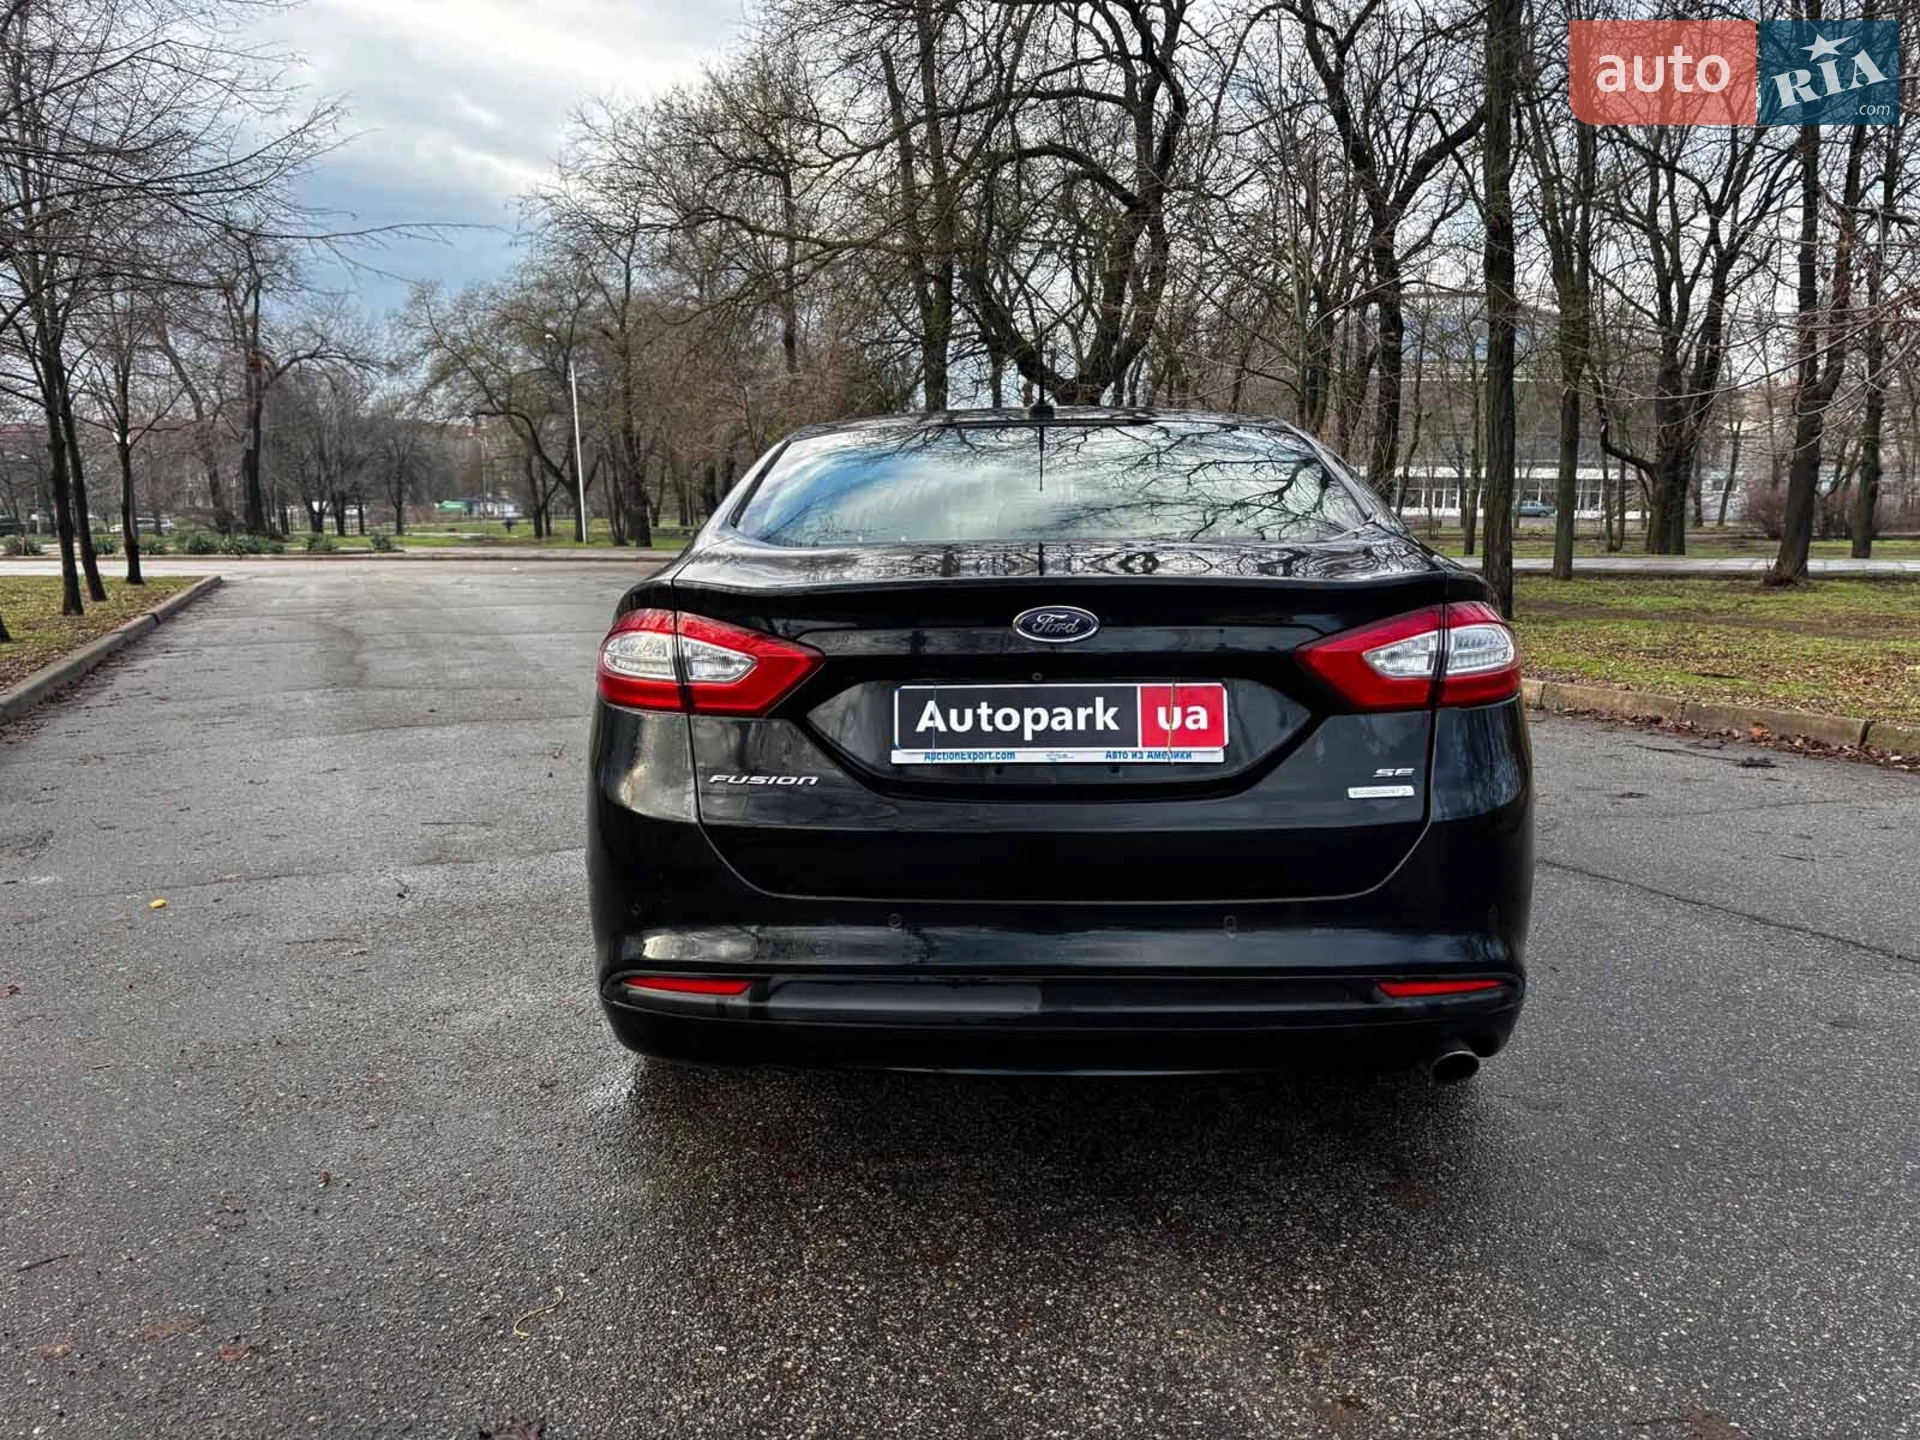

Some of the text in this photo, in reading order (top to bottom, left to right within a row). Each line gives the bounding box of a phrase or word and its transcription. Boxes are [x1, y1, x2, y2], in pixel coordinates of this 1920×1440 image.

[1032, 613, 1080, 633] Ford
[915, 697, 1209, 740] Autopark ua
[709, 774, 819, 785] FUSION
[1373, 768, 1415, 777] SE
